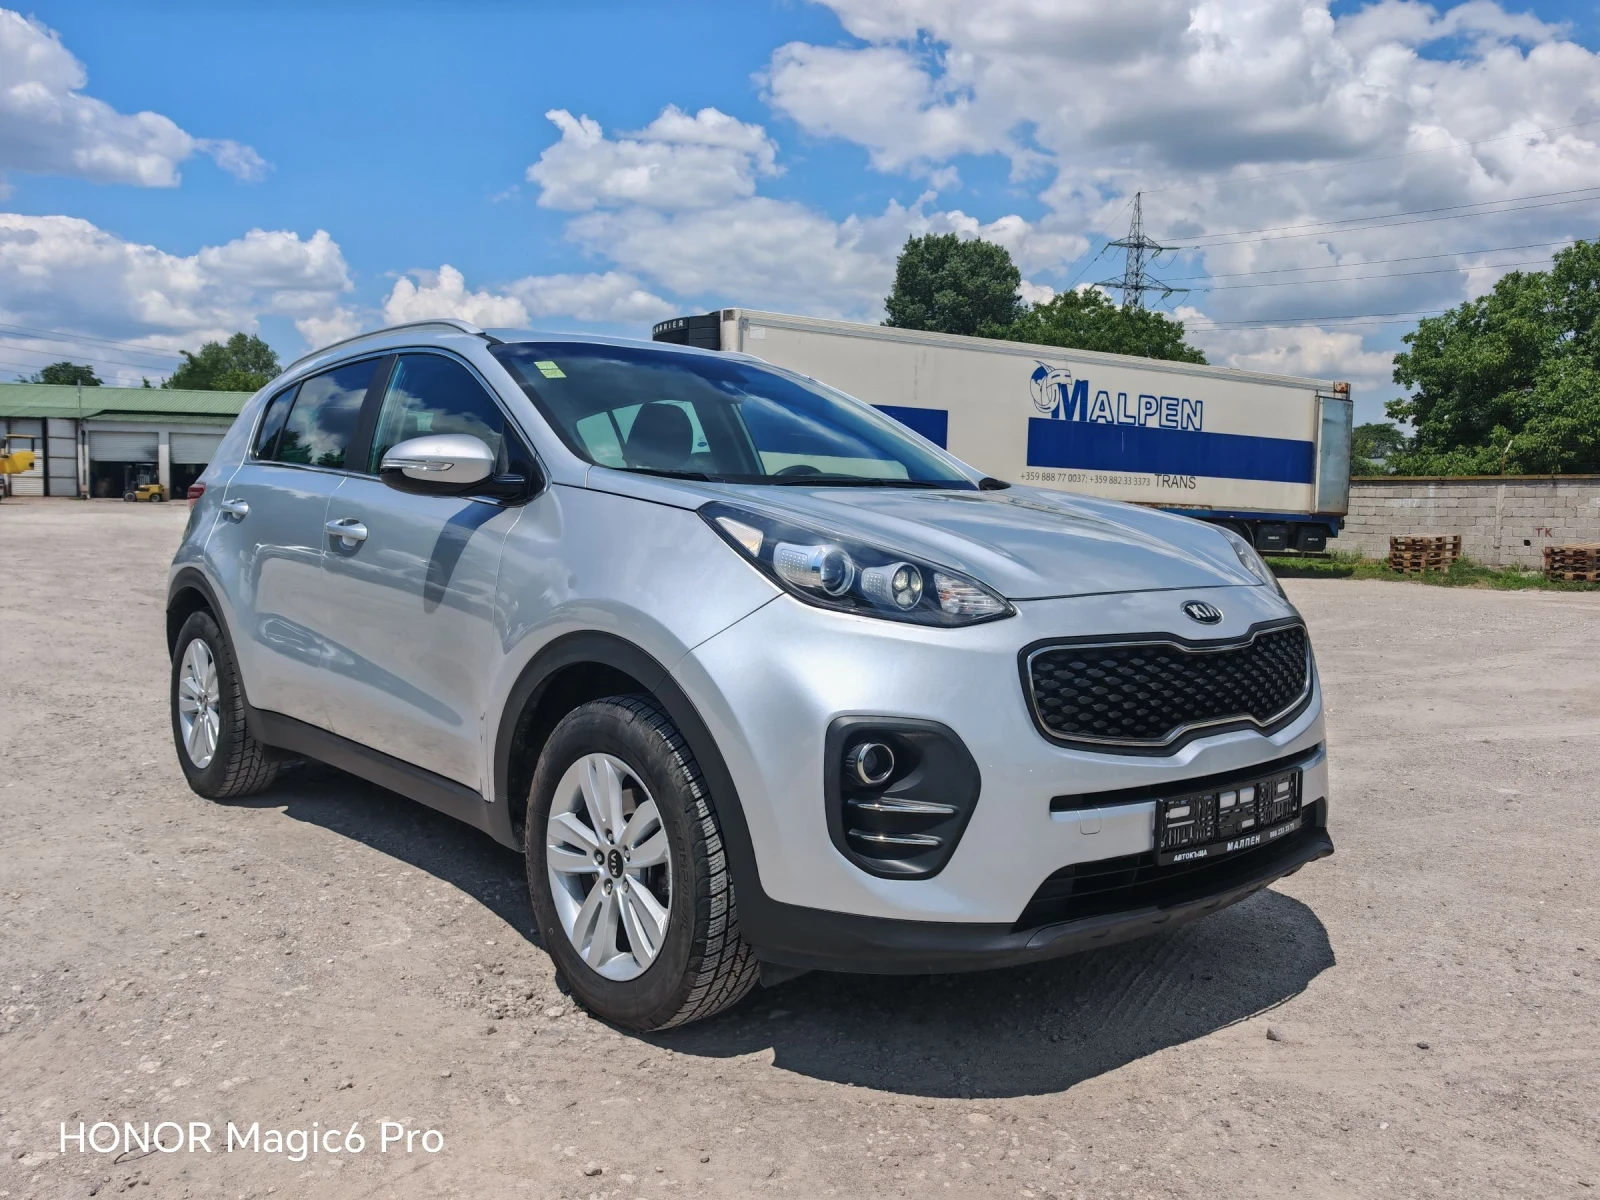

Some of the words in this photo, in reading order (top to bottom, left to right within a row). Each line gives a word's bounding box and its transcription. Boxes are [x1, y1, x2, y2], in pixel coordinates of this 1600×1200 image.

[653, 319, 684, 335] CARRIER
[1050, 379, 1203, 431] MALPEN
[1020, 472, 1040, 481] +359
[1041, 472, 1056, 482] 888
[1057, 473, 1067, 482] 77
[1089, 475, 1108, 484] +359
[1109, 476, 1122, 485] 882
[1154, 473, 1197, 490] TRANS
[1186, 604, 1220, 619] KIA
[1173, 849, 1208, 862] АВТОКЪЩА
[1226, 834, 1261, 852] МАЛПЕН
[610, 852, 618, 876] KIA
